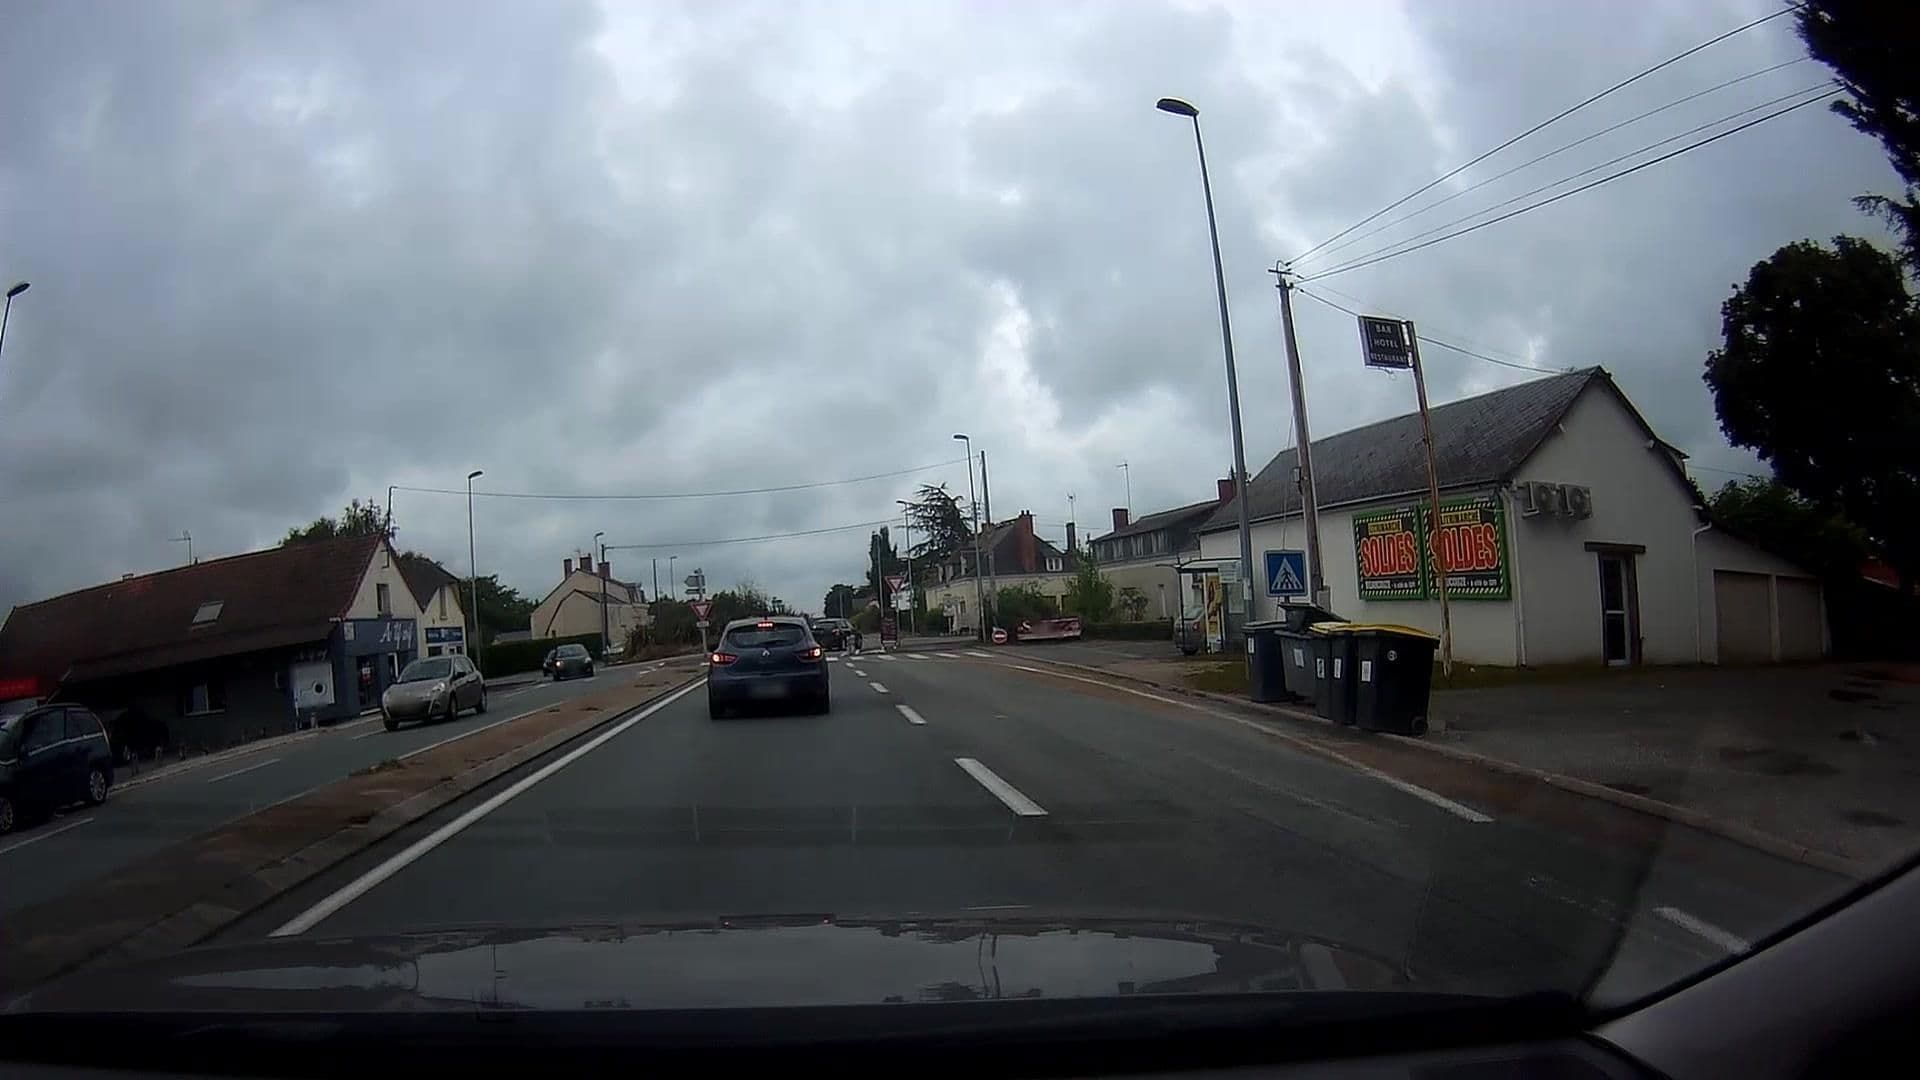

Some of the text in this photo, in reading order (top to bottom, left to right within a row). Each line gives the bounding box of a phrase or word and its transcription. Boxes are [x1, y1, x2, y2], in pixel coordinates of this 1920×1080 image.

[1375, 324, 1392, 334] BAR
[1373, 338, 1398, 348] HOTEL
[1361, 531, 1416, 576] SOLDES
